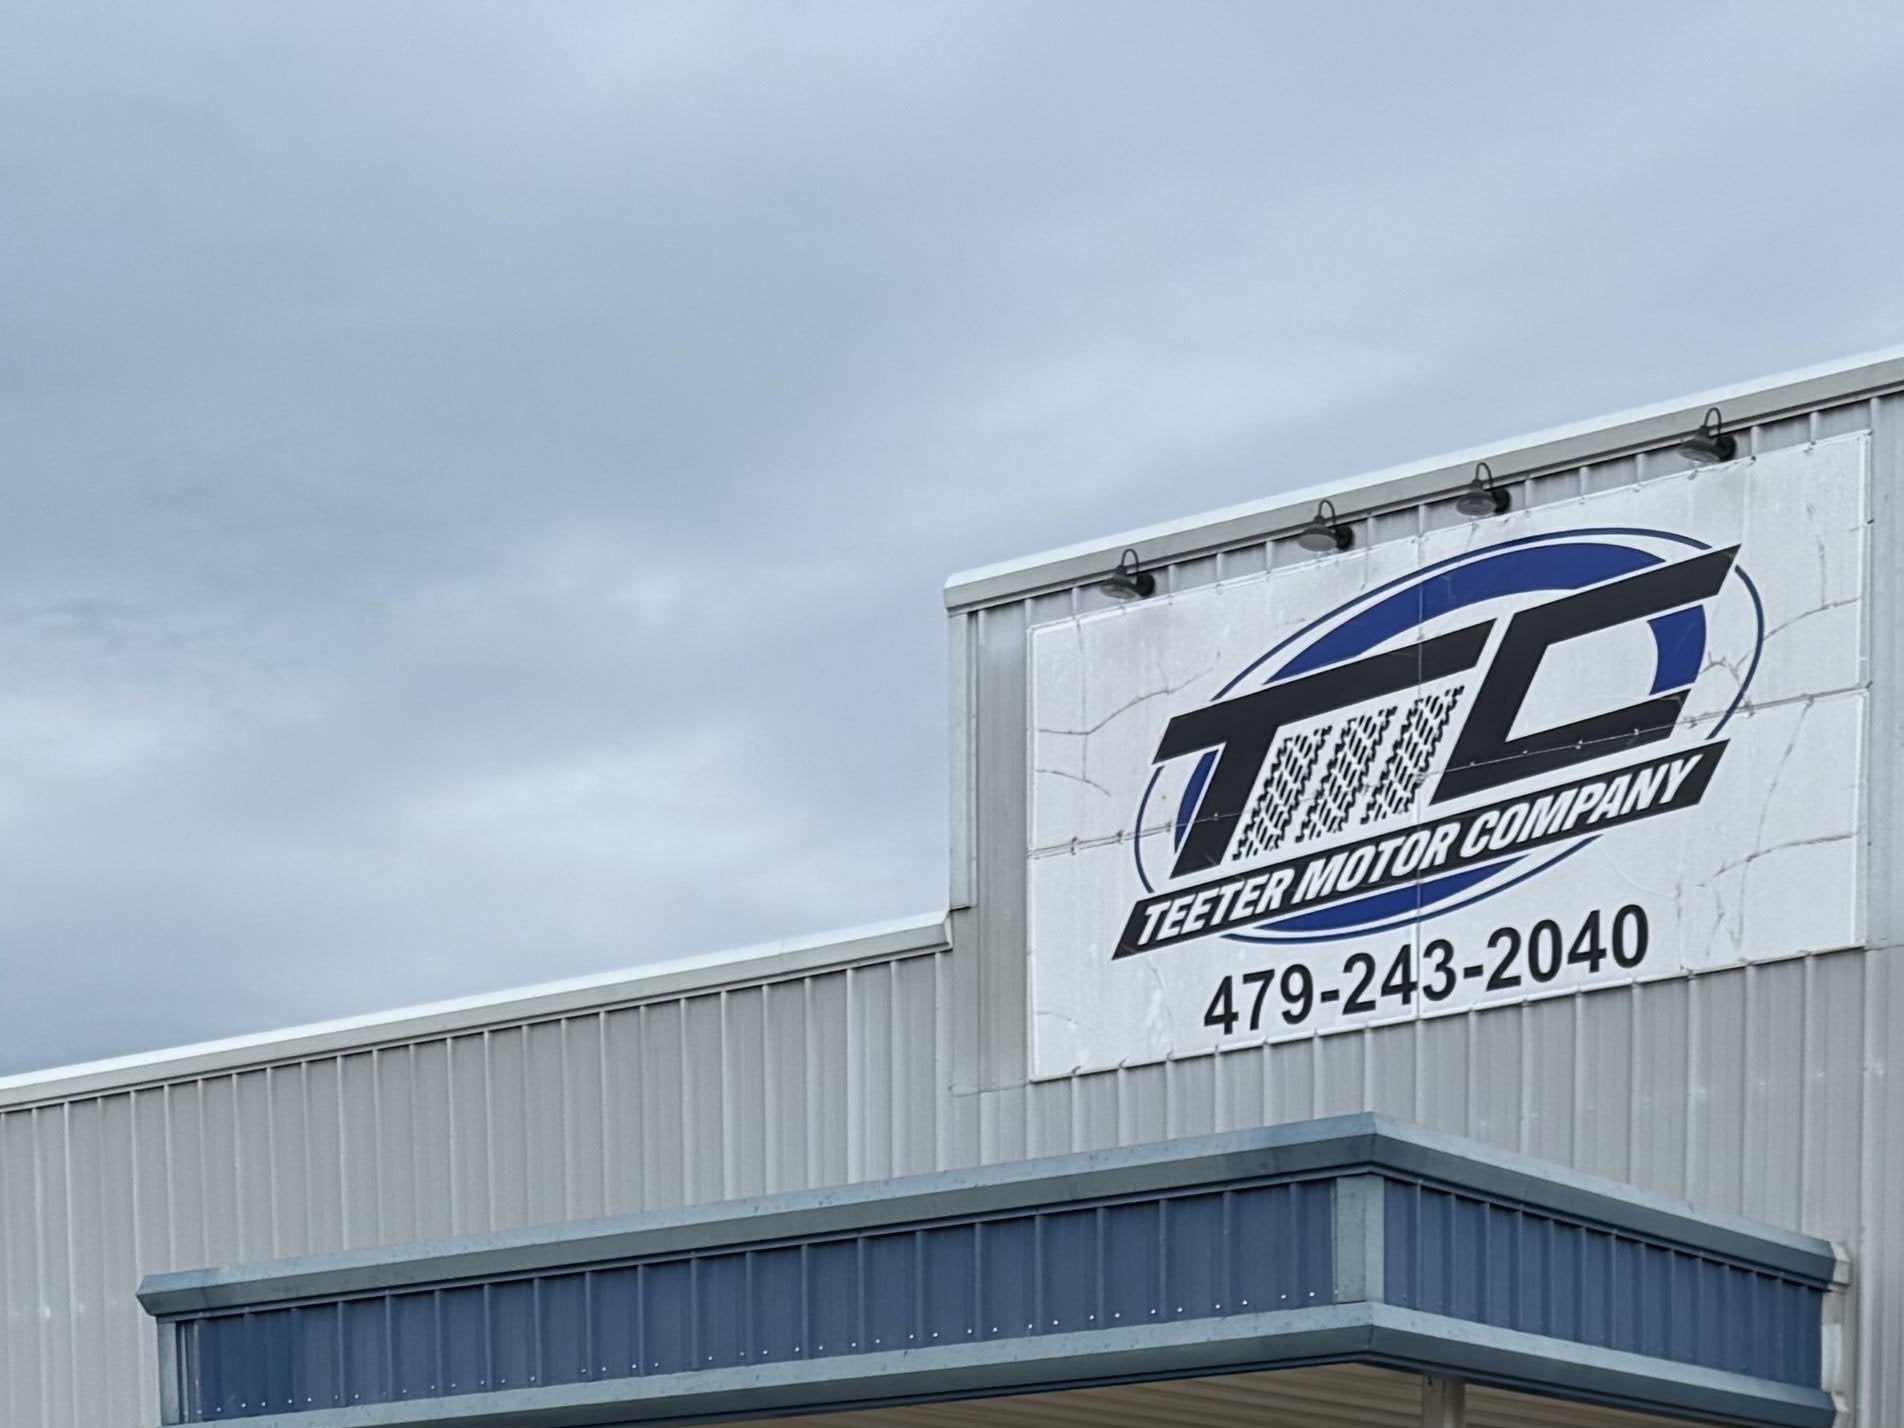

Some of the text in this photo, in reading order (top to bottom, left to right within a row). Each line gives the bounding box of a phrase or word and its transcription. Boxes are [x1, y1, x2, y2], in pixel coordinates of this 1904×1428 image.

[1138, 754, 1704, 946] TEETER MOTOR COMPANY
[1203, 904, 1649, 1035] 479-243-2040
